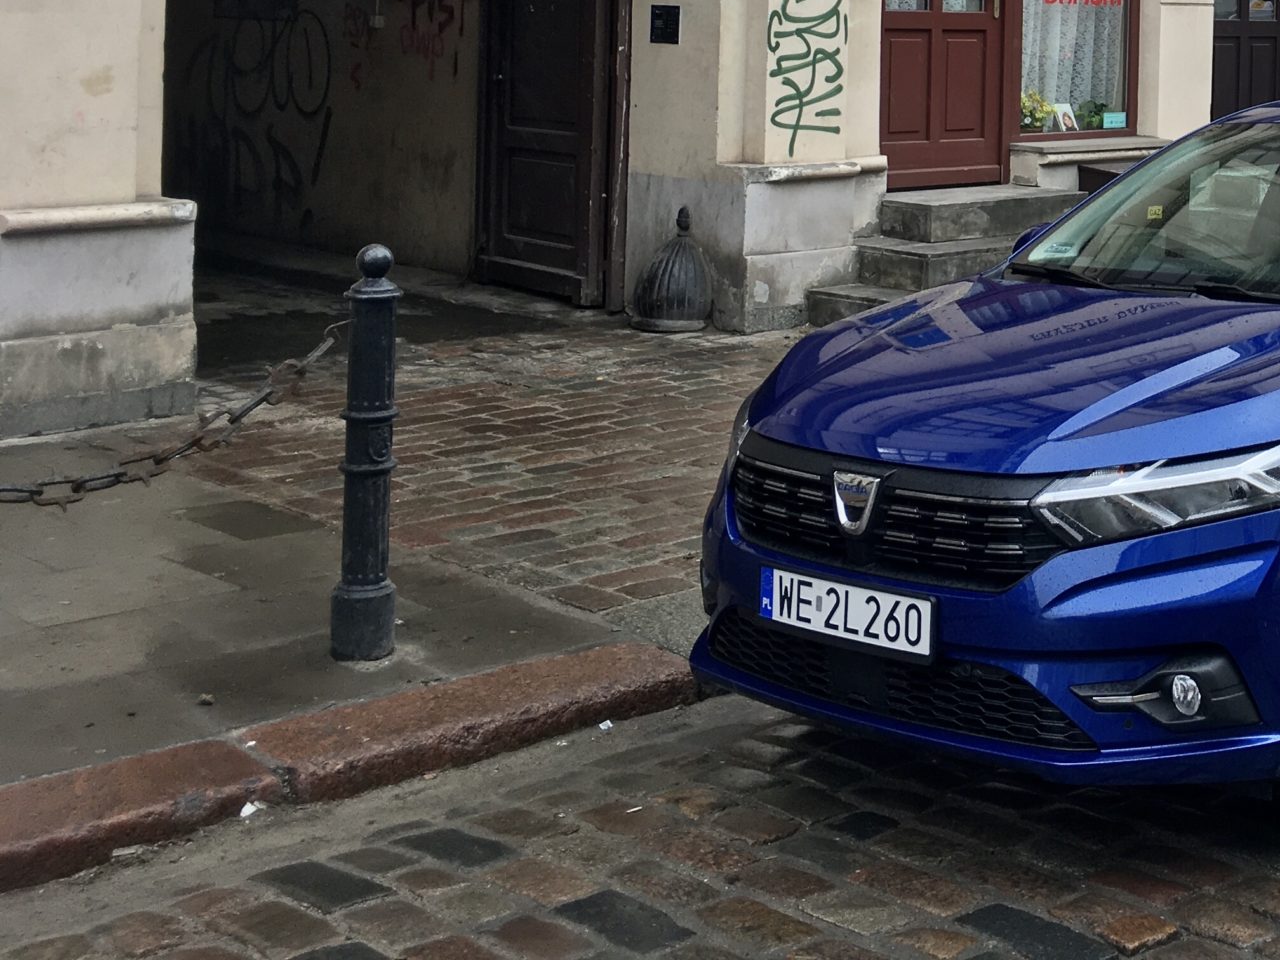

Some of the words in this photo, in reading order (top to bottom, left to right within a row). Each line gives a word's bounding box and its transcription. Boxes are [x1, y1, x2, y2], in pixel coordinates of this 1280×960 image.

[761, 596, 772, 611] PL
[778, 574, 814, 625] WE
[824, 586, 923, 648] 2L260
